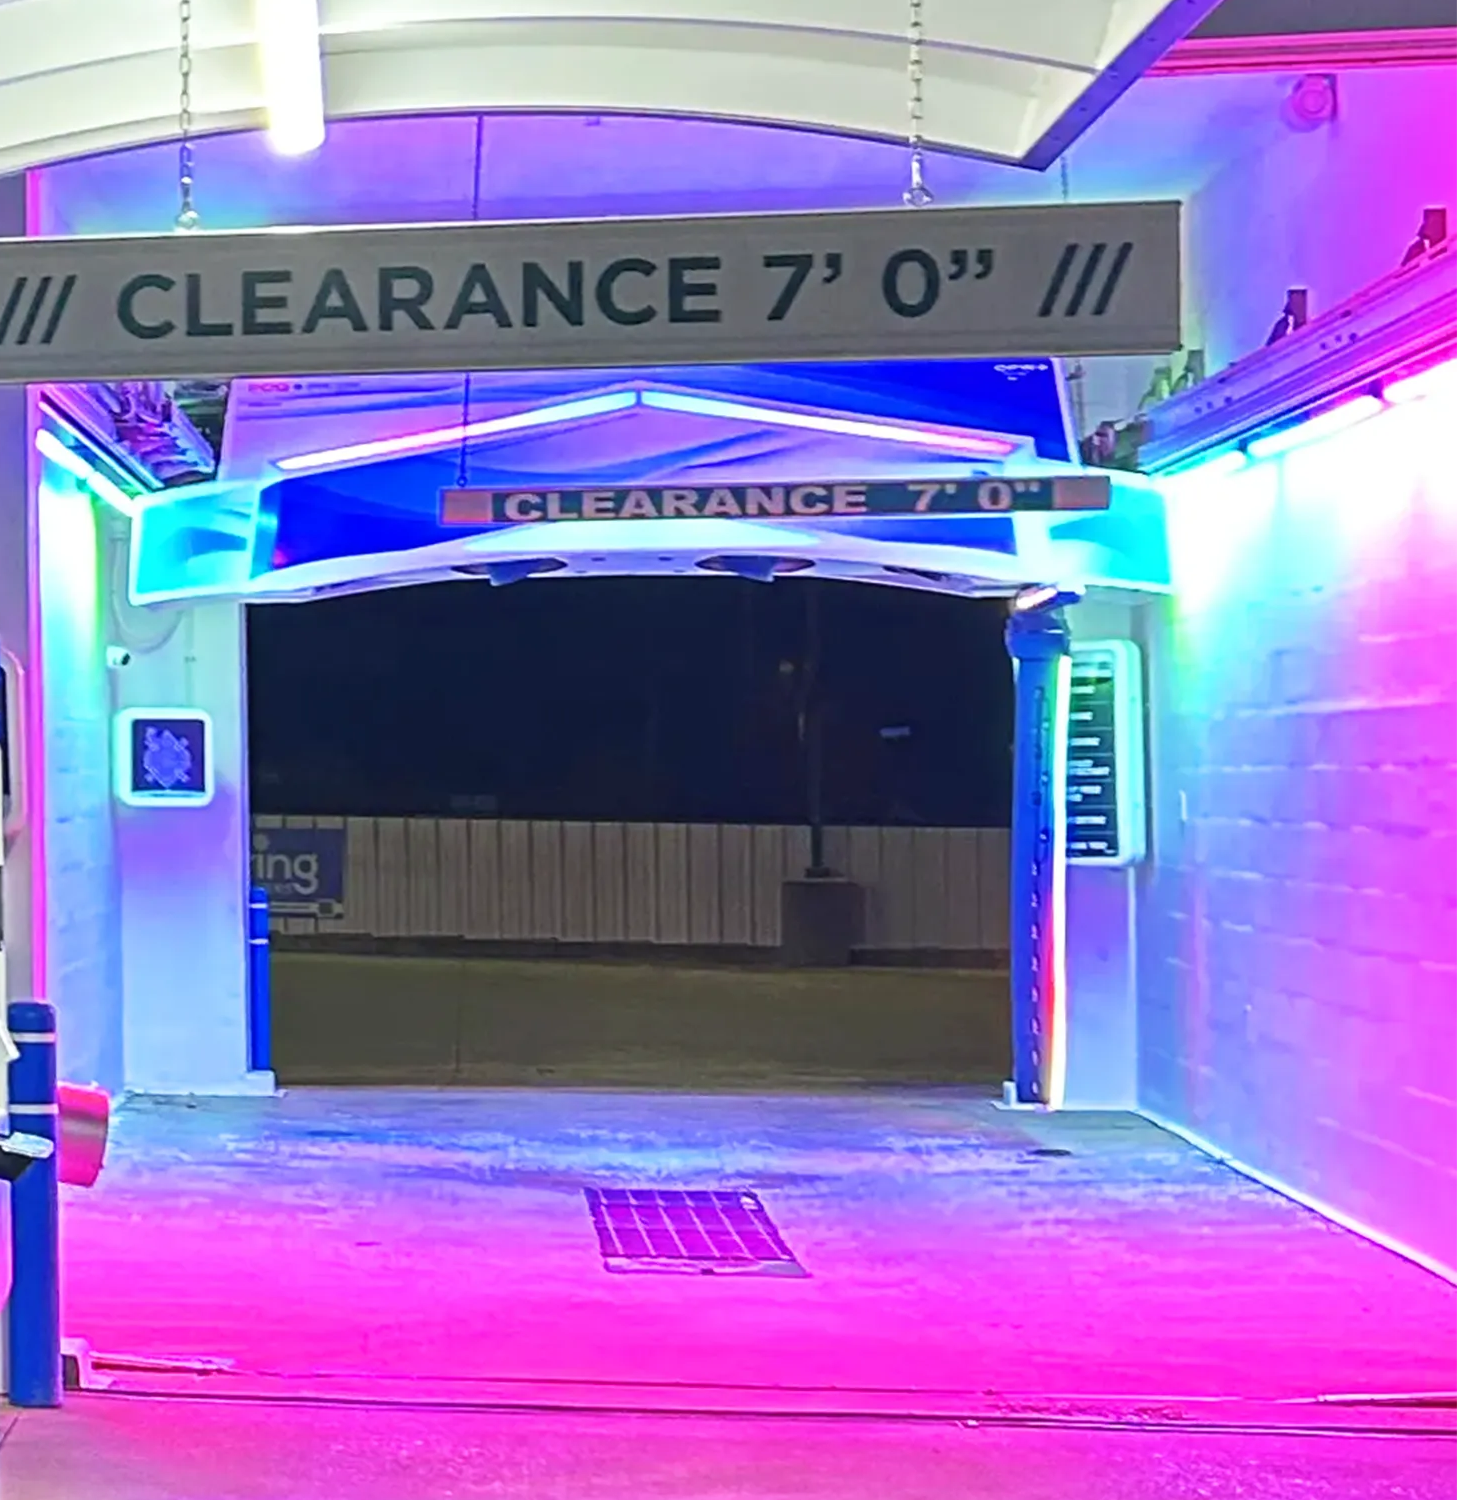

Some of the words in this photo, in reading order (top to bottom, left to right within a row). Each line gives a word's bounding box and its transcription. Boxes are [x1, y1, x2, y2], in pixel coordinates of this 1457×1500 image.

[116, 254, 723, 340] CLEARANCE
[503, 483, 869, 521] CLEARANCE
[252, 833, 320, 896] ing
